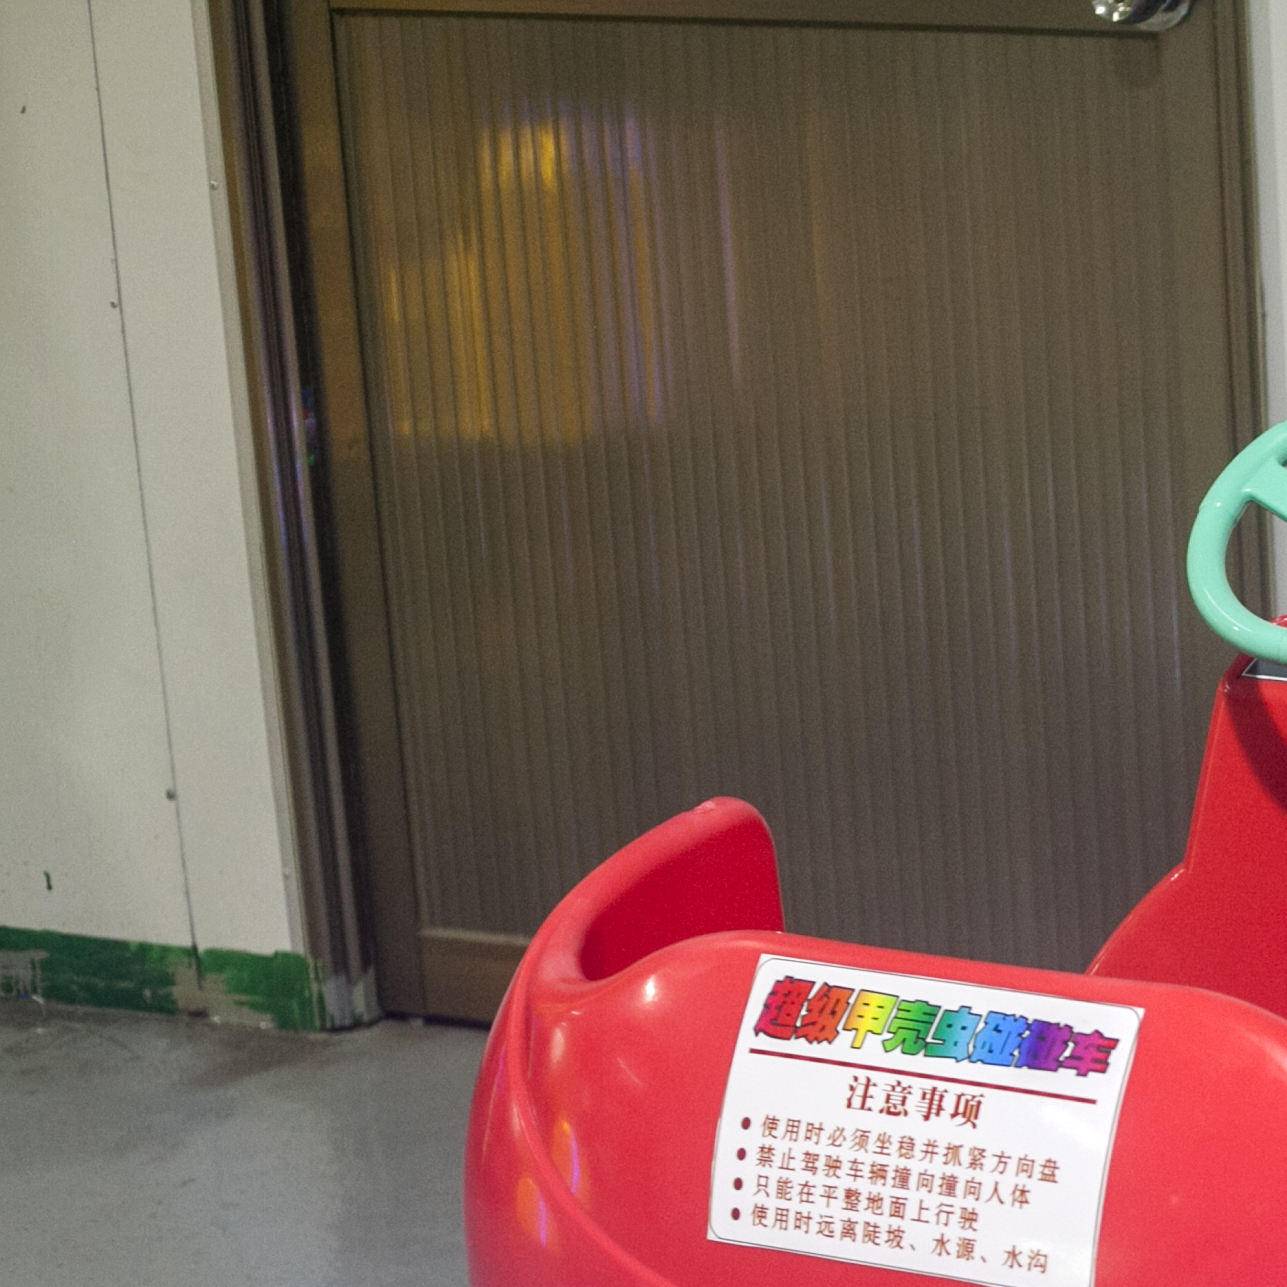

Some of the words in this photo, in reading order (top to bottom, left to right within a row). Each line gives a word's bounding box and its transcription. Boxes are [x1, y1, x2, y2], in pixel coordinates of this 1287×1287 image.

[754, 976, 1120, 1077] 超级甲壳虫碰碰车
[846, 1075, 985, 1129] 注意事项
[755, 1144, 1031, 1210] 禁止驾驶车辆撞向撞向人体
[761, 1114, 1060, 1184] 使用时必须坐稳并抓紧方向盘
[753, 1173, 979, 1232] 只能在平整地面上行驶
[751, 1202, 1048, 1275] 使用时远离陡坡、水源、水沟
